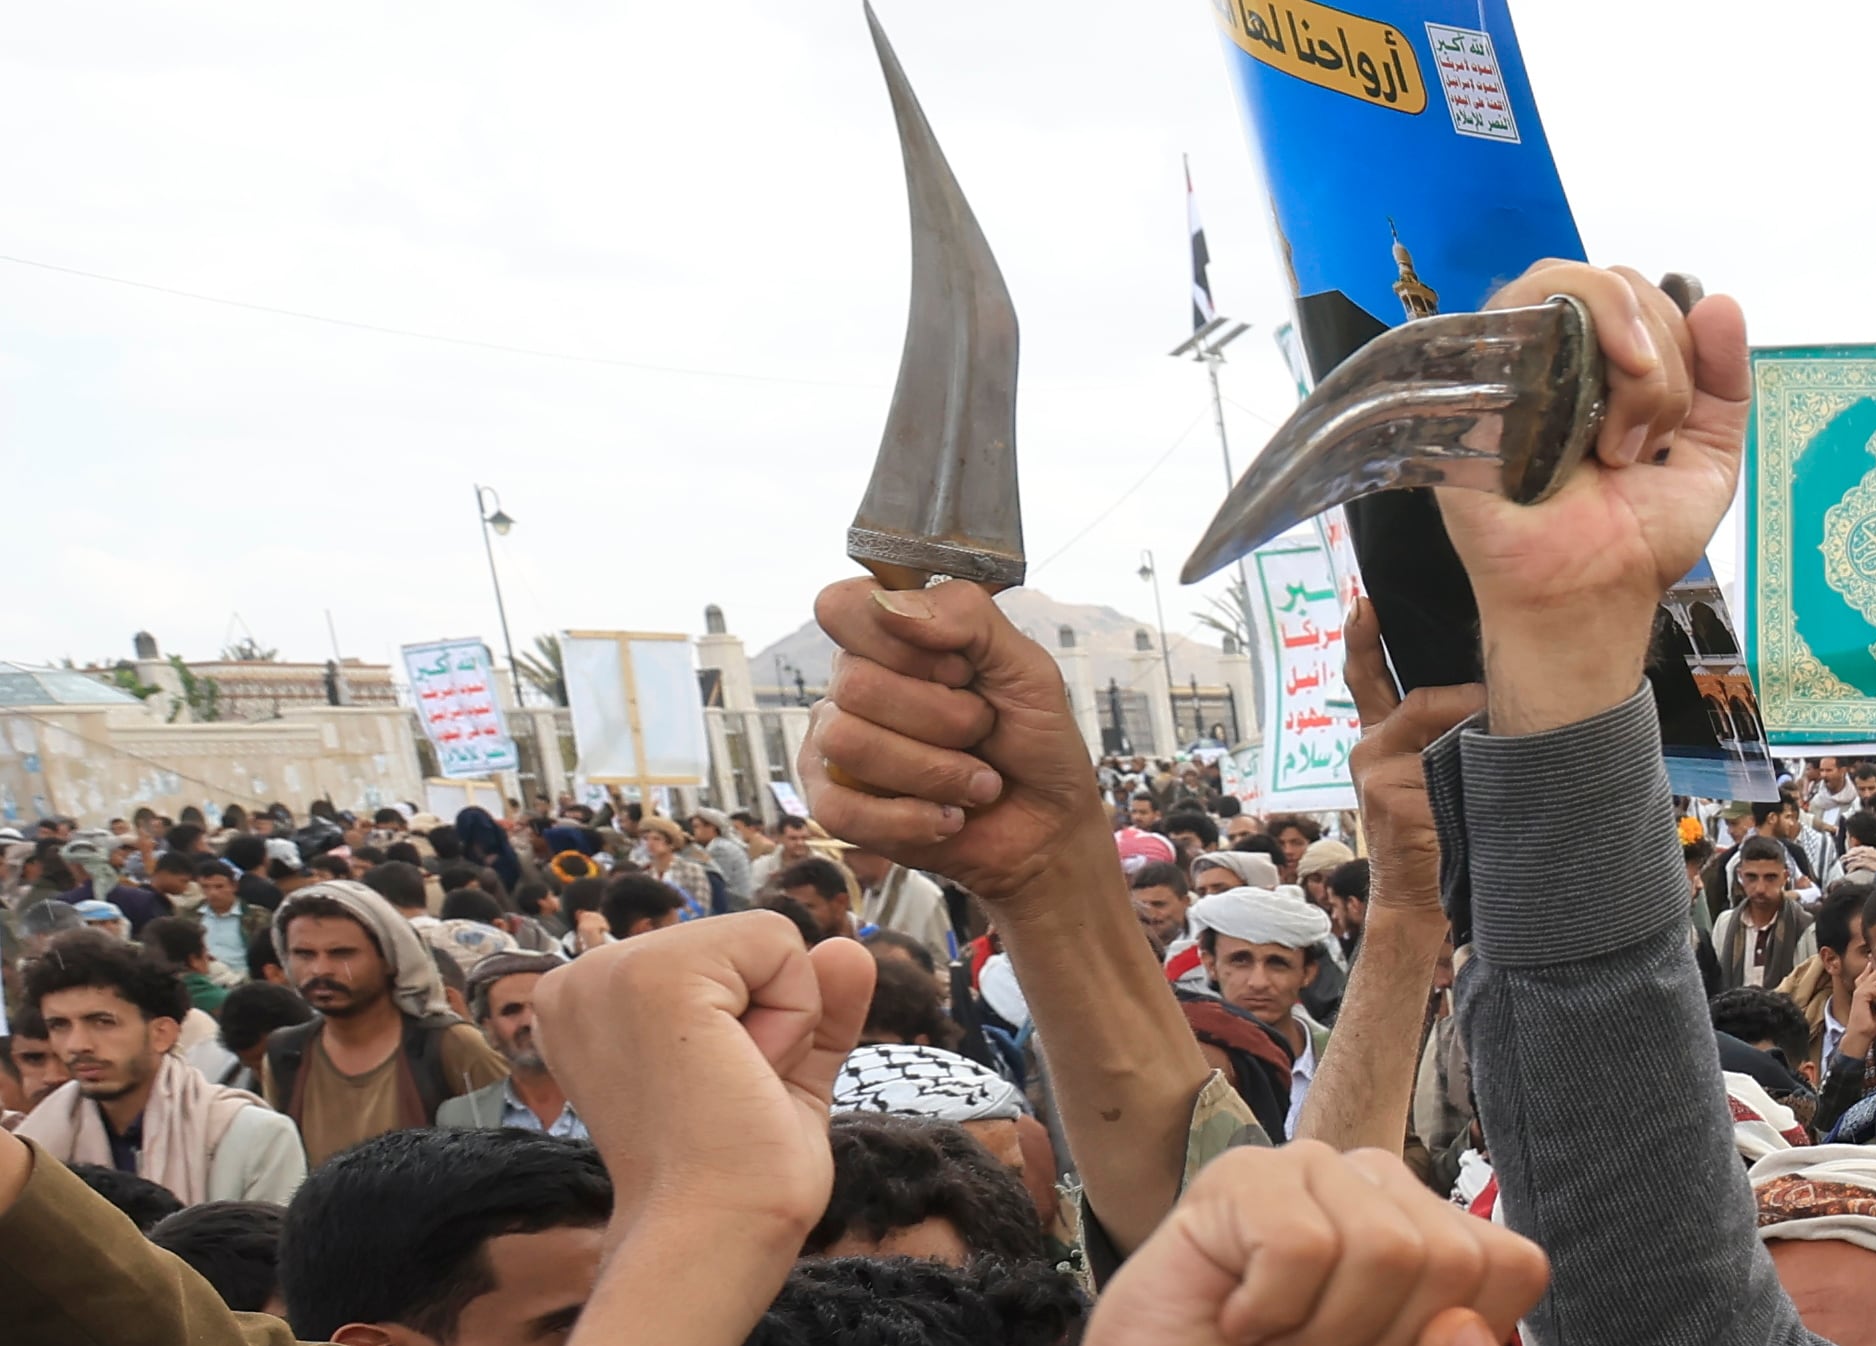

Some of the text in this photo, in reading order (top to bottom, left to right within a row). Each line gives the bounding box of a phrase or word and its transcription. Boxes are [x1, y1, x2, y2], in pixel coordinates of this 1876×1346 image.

[1285, 10, 1409, 103] أرواحنا
[1436, 33, 1490, 56] الله أكبر
